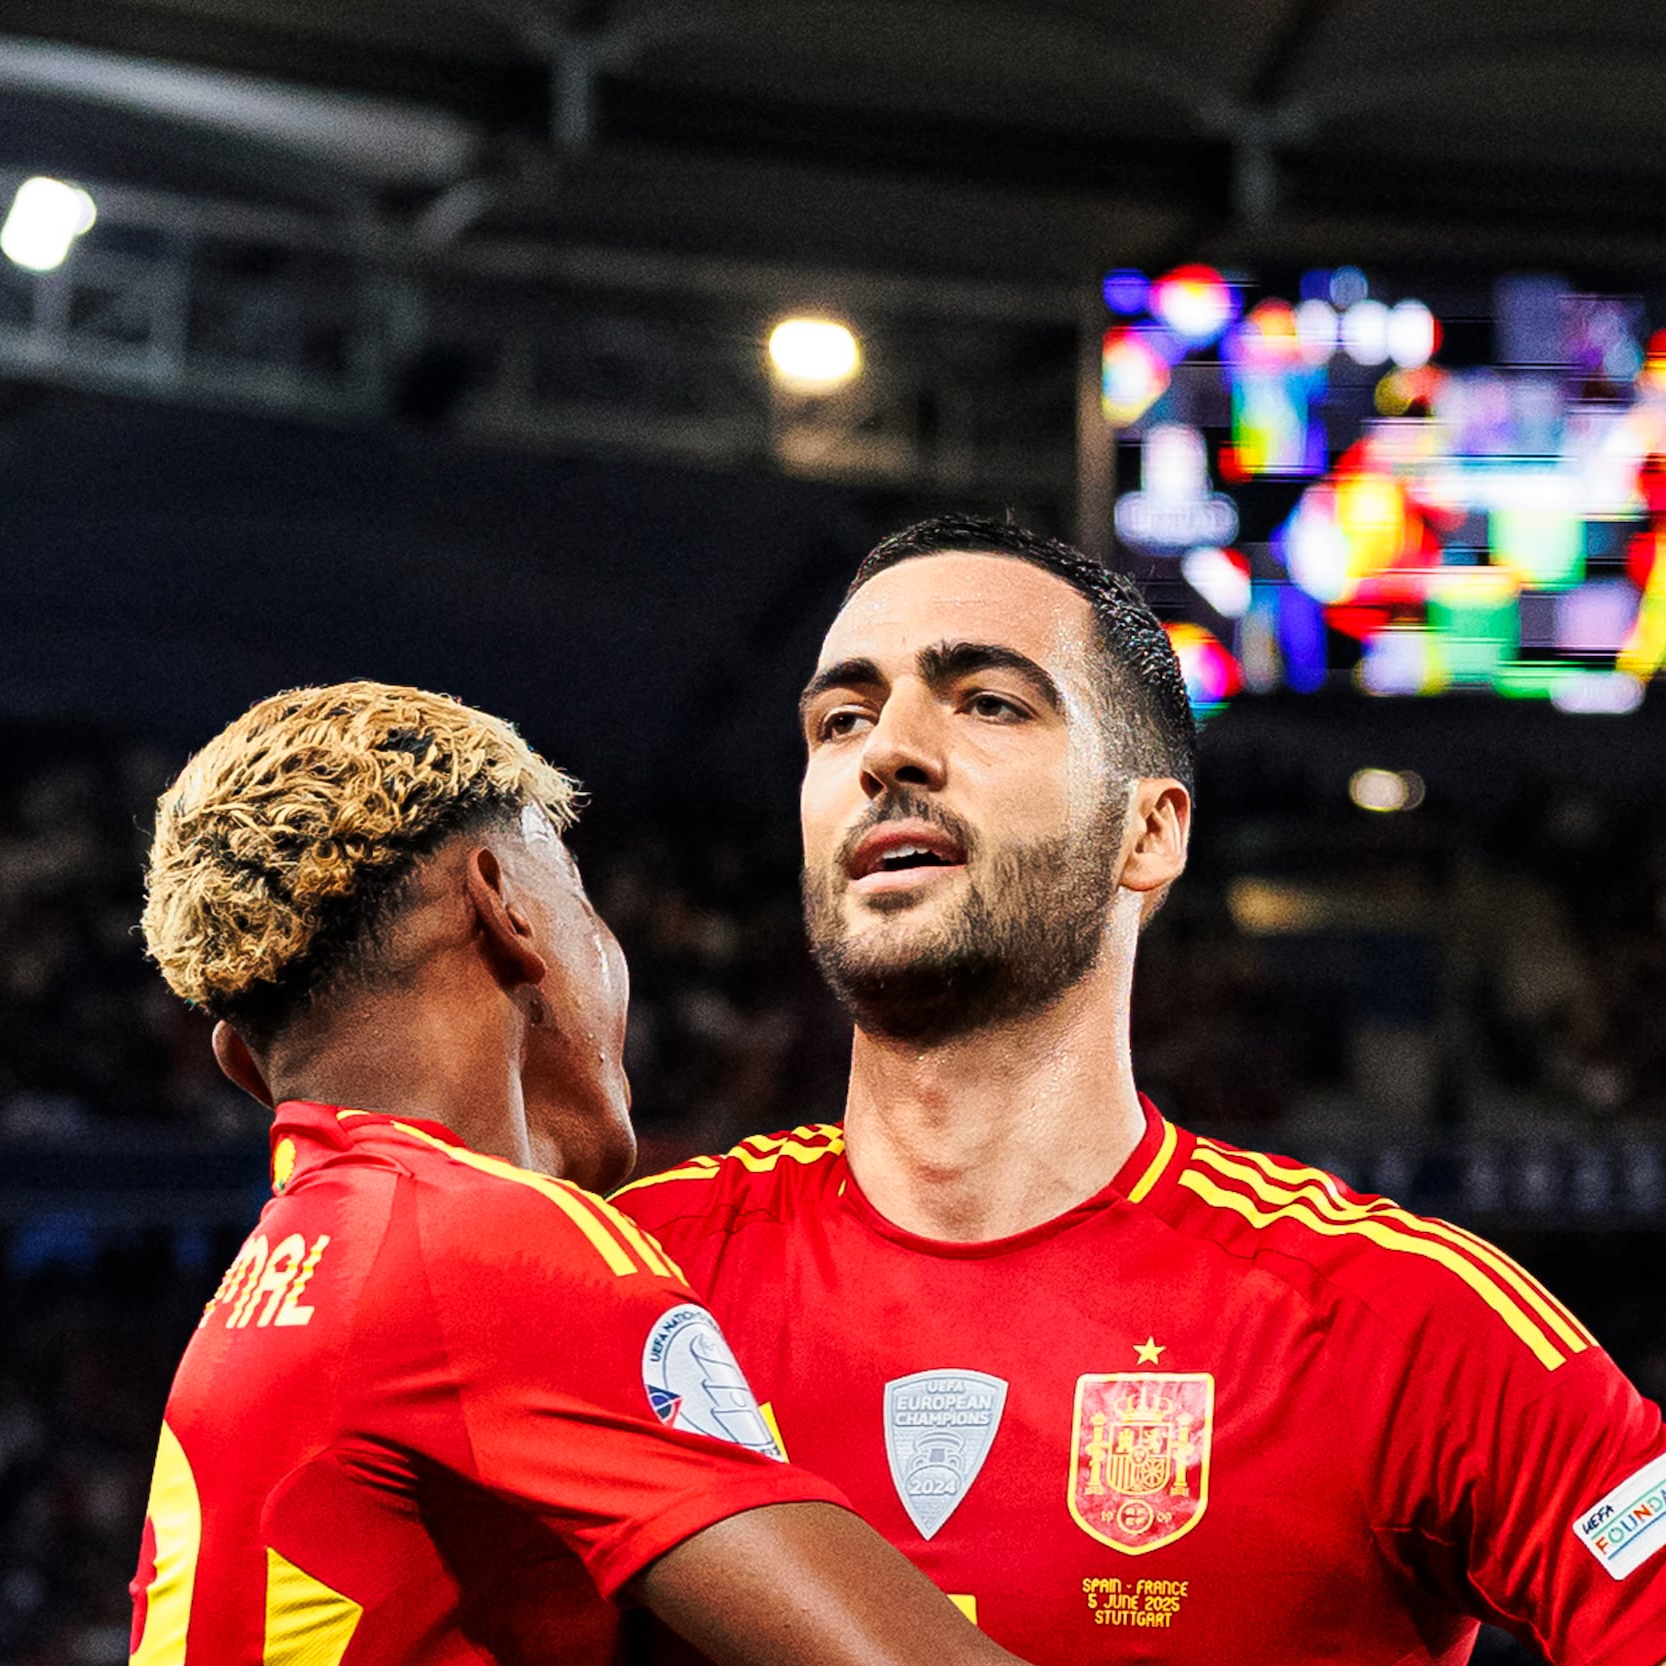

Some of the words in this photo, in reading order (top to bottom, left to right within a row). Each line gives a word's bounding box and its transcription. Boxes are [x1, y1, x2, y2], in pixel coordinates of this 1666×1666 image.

[649, 1333, 669, 1362] UEFA
[926, 1381, 966, 1394] UEFA
[896, 1396, 992, 1411] EUROPEAN
[895, 1411, 990, 1427] CHAMPIONS
[909, 1480, 957, 1496] 2024
[1581, 1504, 1615, 1535] UEFA
[1082, 1577, 1122, 1594] SPAIN
[1136, 1579, 1190, 1597] FRANCE
[1087, 1593, 1098, 1609] 5
[1103, 1594, 1139, 1610] JUNE
[1144, 1596, 1181, 1612] 2025
[1094, 1609, 1173, 1628] STUTTGART
